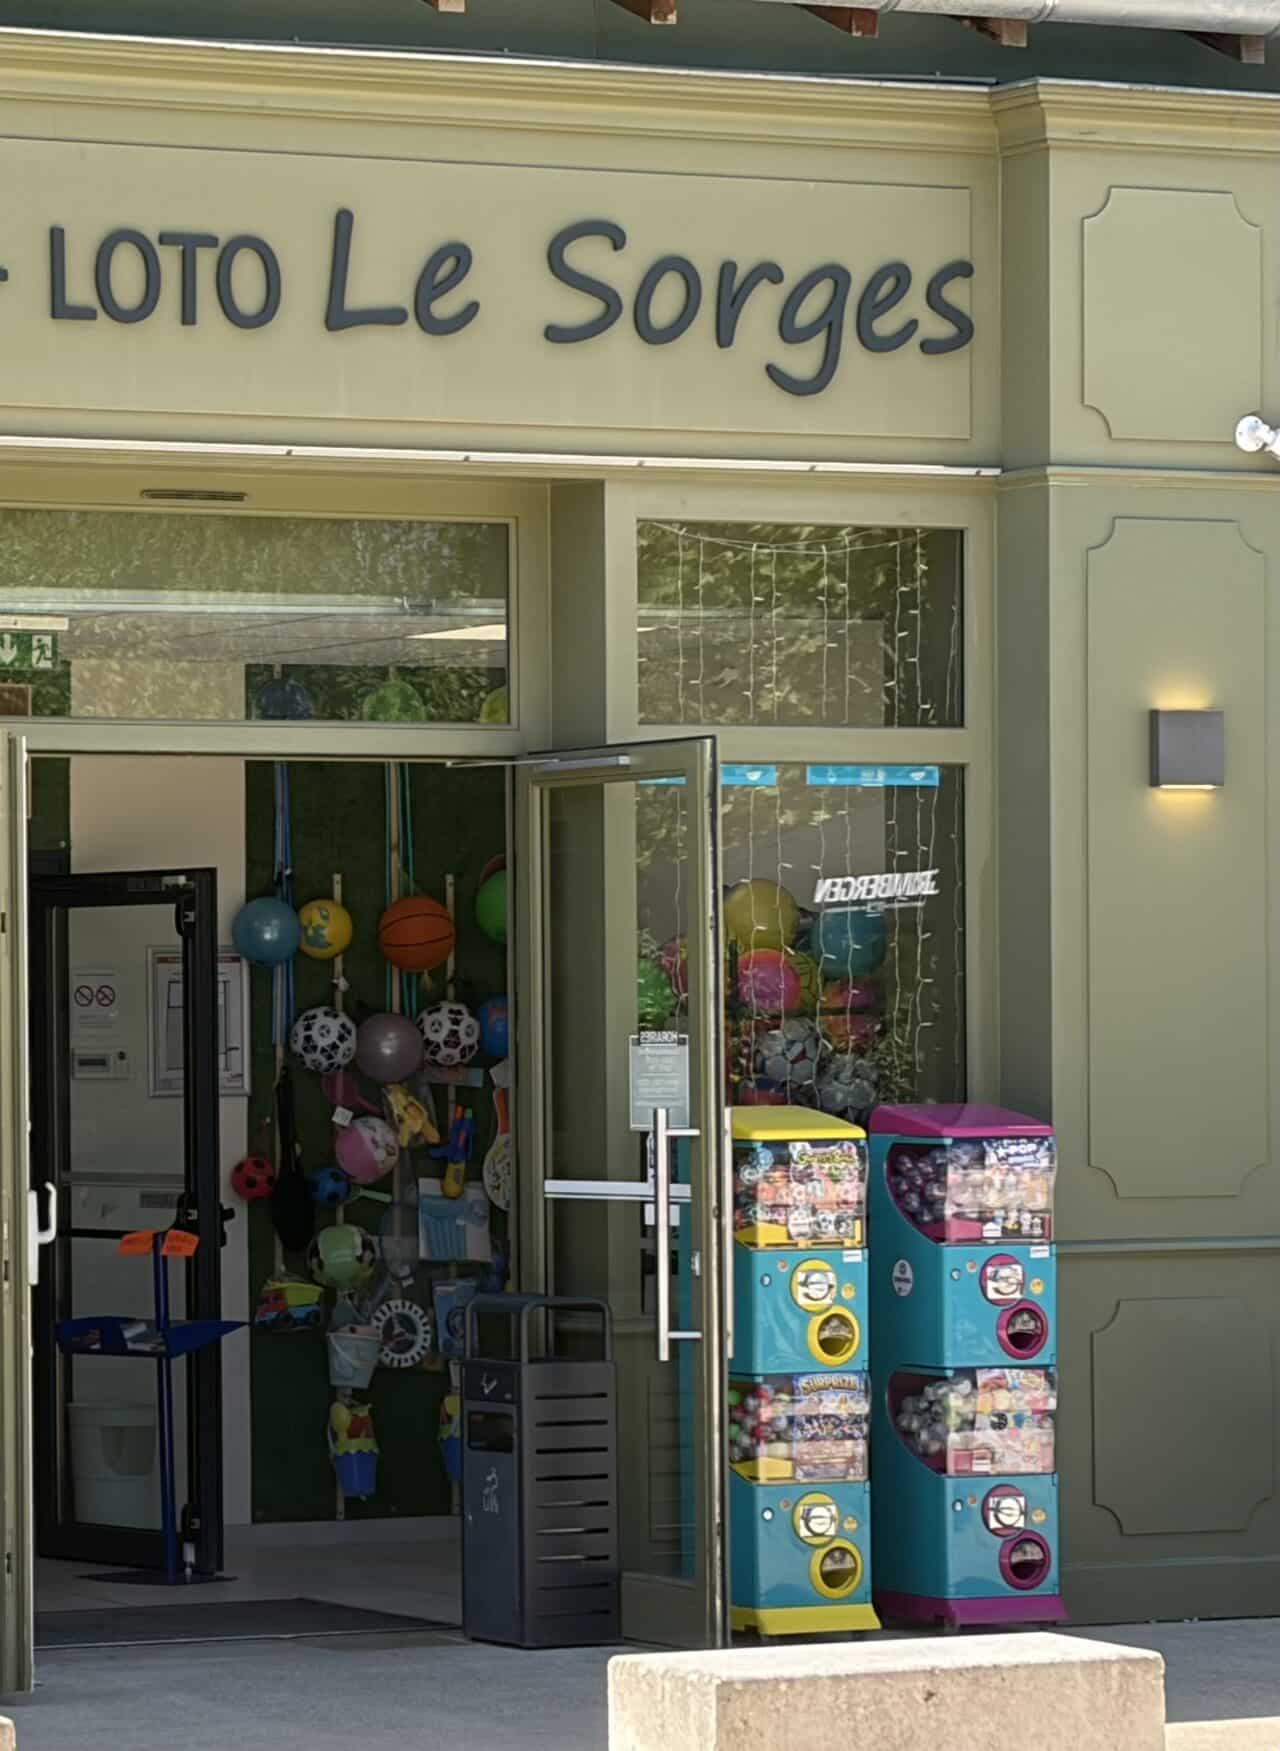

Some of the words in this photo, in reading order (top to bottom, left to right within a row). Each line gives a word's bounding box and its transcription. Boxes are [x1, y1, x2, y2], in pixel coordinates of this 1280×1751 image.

[49, 225, 281, 329] LOTO
[324, 207, 481, 336] Le
[543, 218, 975, 396] Sorges
